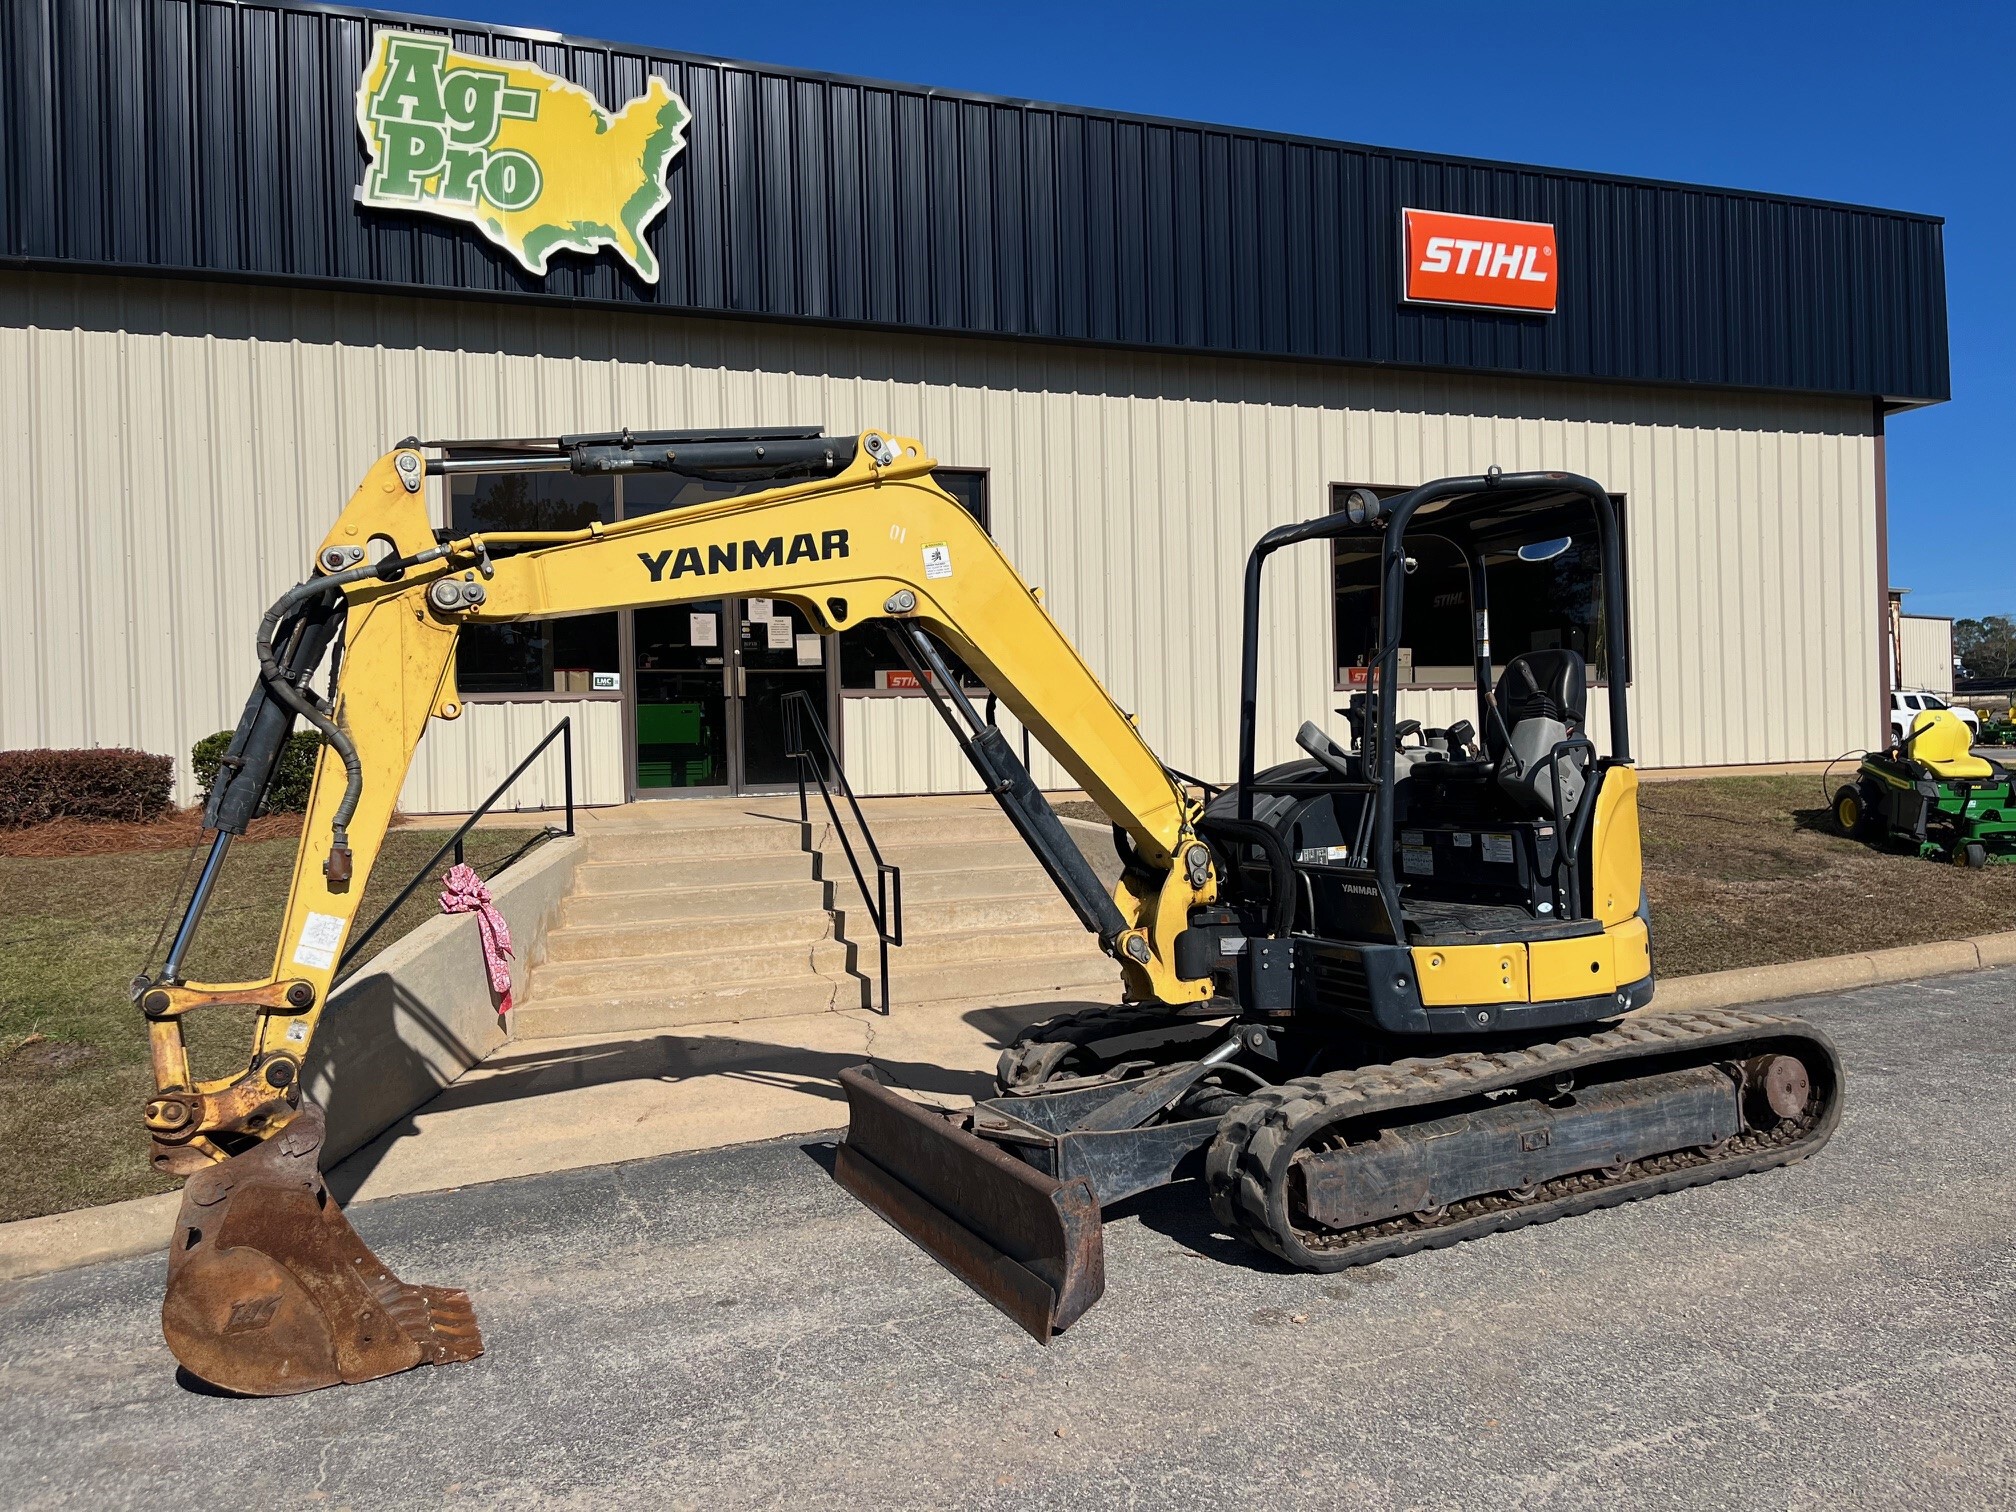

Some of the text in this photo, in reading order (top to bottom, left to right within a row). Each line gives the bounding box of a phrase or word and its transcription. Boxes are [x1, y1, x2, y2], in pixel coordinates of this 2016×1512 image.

[368, 37, 539, 147] Ag-
[370, 118, 542, 210] Pro
[637, 528, 850, 582] YANMAR
[891, 676, 920, 687] STIH
[1341, 883, 1378, 897] YANMAR
